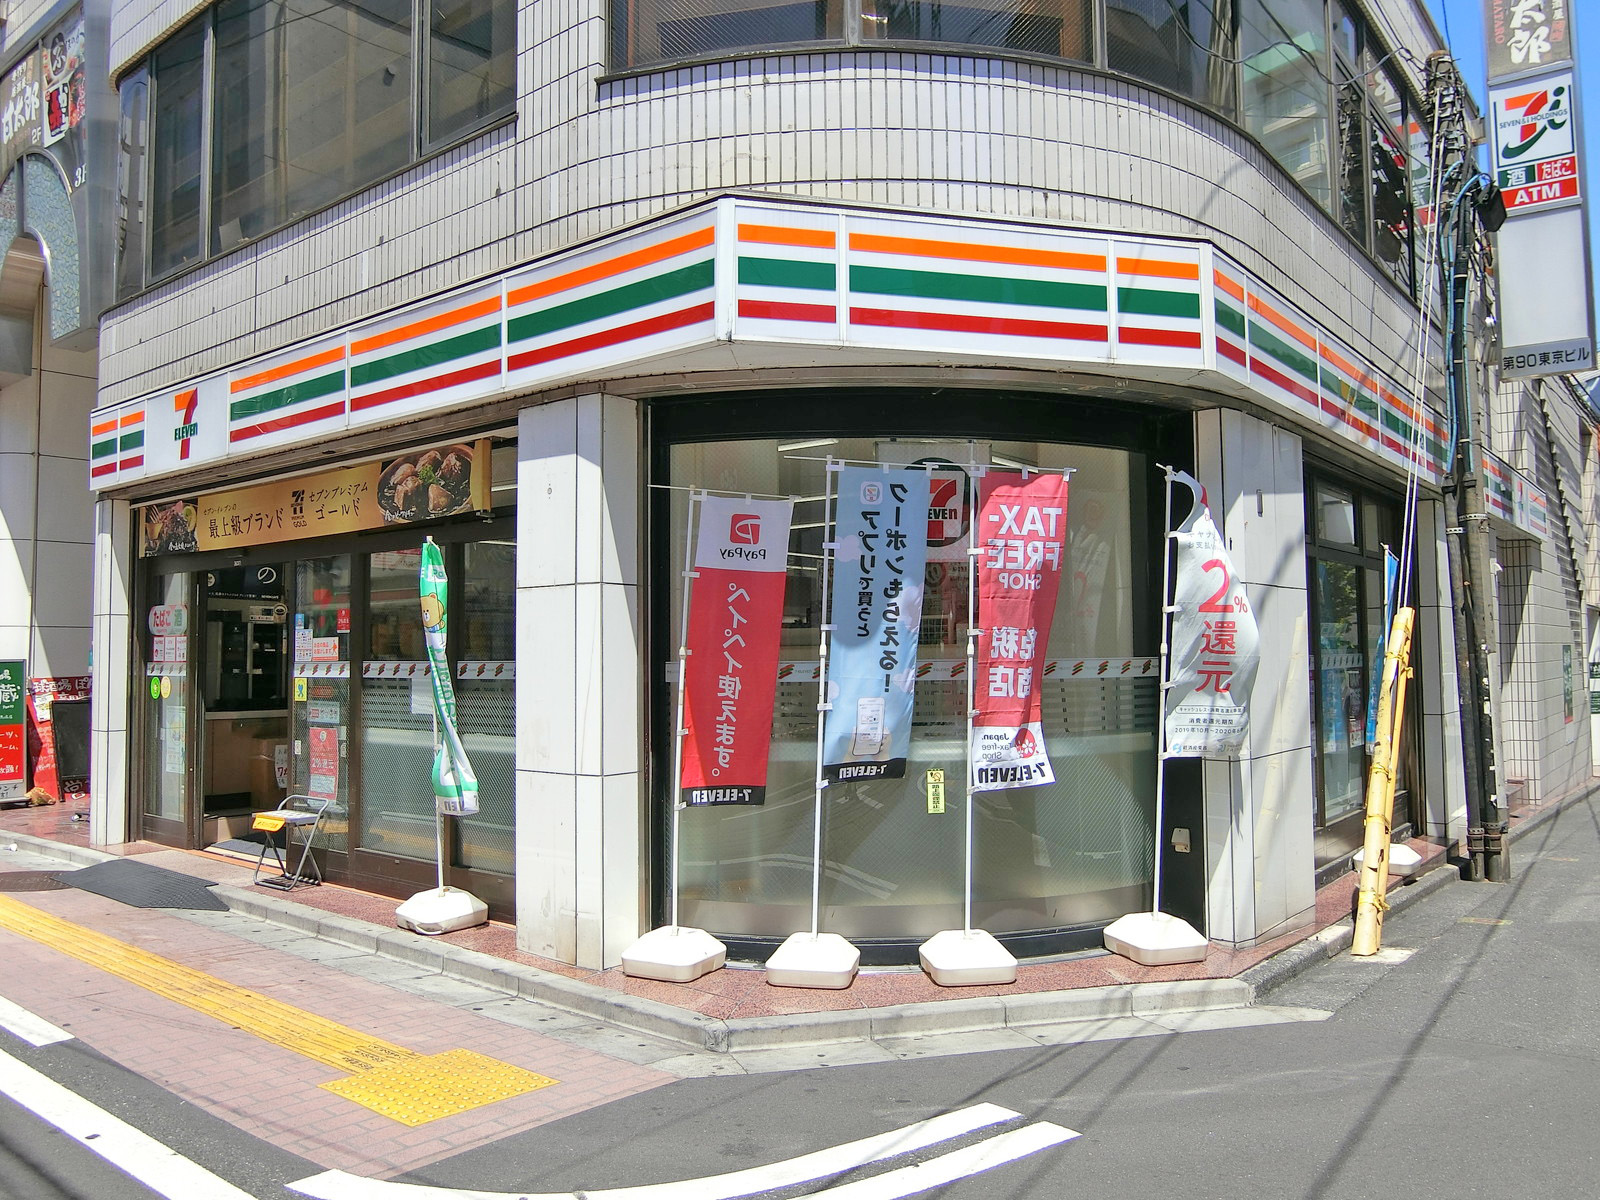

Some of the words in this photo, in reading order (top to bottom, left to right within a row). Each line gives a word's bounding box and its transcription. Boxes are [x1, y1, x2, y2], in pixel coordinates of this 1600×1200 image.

[1499, 118, 1521, 129] SEVEN
[1530, 108, 1568, 124] HOLDINGS
[1506, 167, 1526, 187] 酒
[1541, 159, 1572, 180] たばこ
[1513, 182, 1561, 205] ATM
[1503, 347, 1590, 371] 第90東京ビル
[309, 481, 369, 503] セブンプレミアム
[315, 497, 361, 520] ゴールド
[208, 508, 285, 539] 最上級ブランド
[293, 520, 308, 528] GOLD
[1195, 619, 1239, 694] 還元
[1188, 717, 1234, 726] 消費者還元期間
